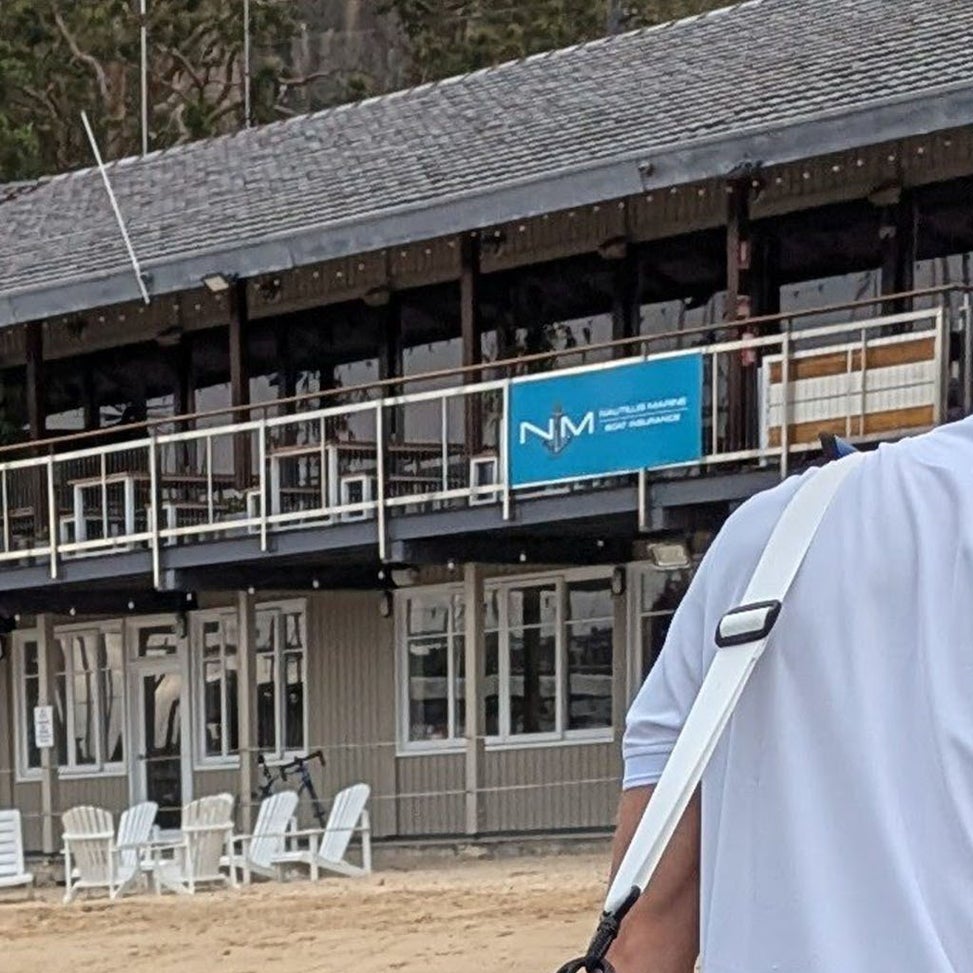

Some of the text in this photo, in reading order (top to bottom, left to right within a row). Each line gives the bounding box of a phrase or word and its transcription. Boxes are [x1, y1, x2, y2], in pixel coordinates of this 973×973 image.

[646, 396, 687, 410] MARINE
[519, 410, 595, 445] NM
[604, 413, 681, 432] BOAT INSURANCE
